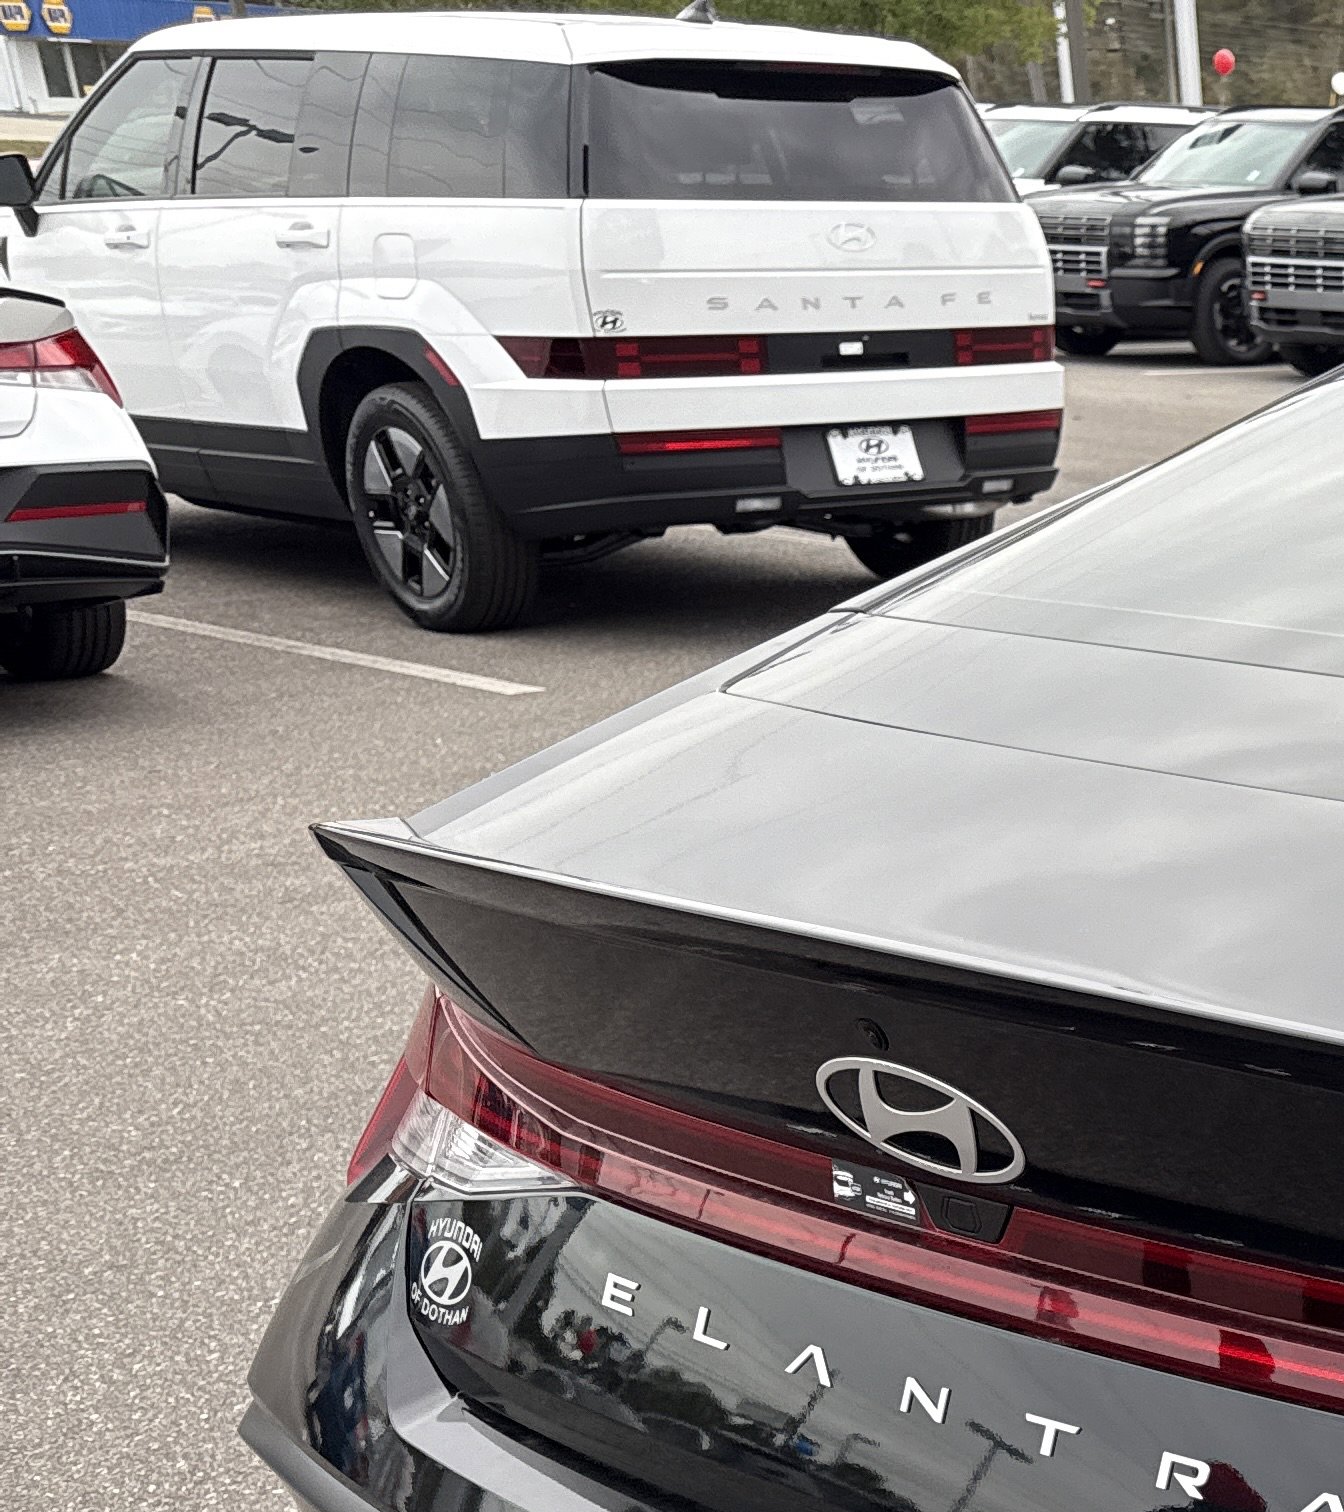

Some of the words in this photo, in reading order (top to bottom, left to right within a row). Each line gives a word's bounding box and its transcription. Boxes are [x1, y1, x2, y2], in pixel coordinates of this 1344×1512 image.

[706, 296, 905, 312] SANTA
[940, 291, 992, 307] FE
[428, 1217, 482, 1262] HYUNDAI
[411, 1282, 423, 1304] OF
[421, 1299, 469, 1326] DOTHAN
